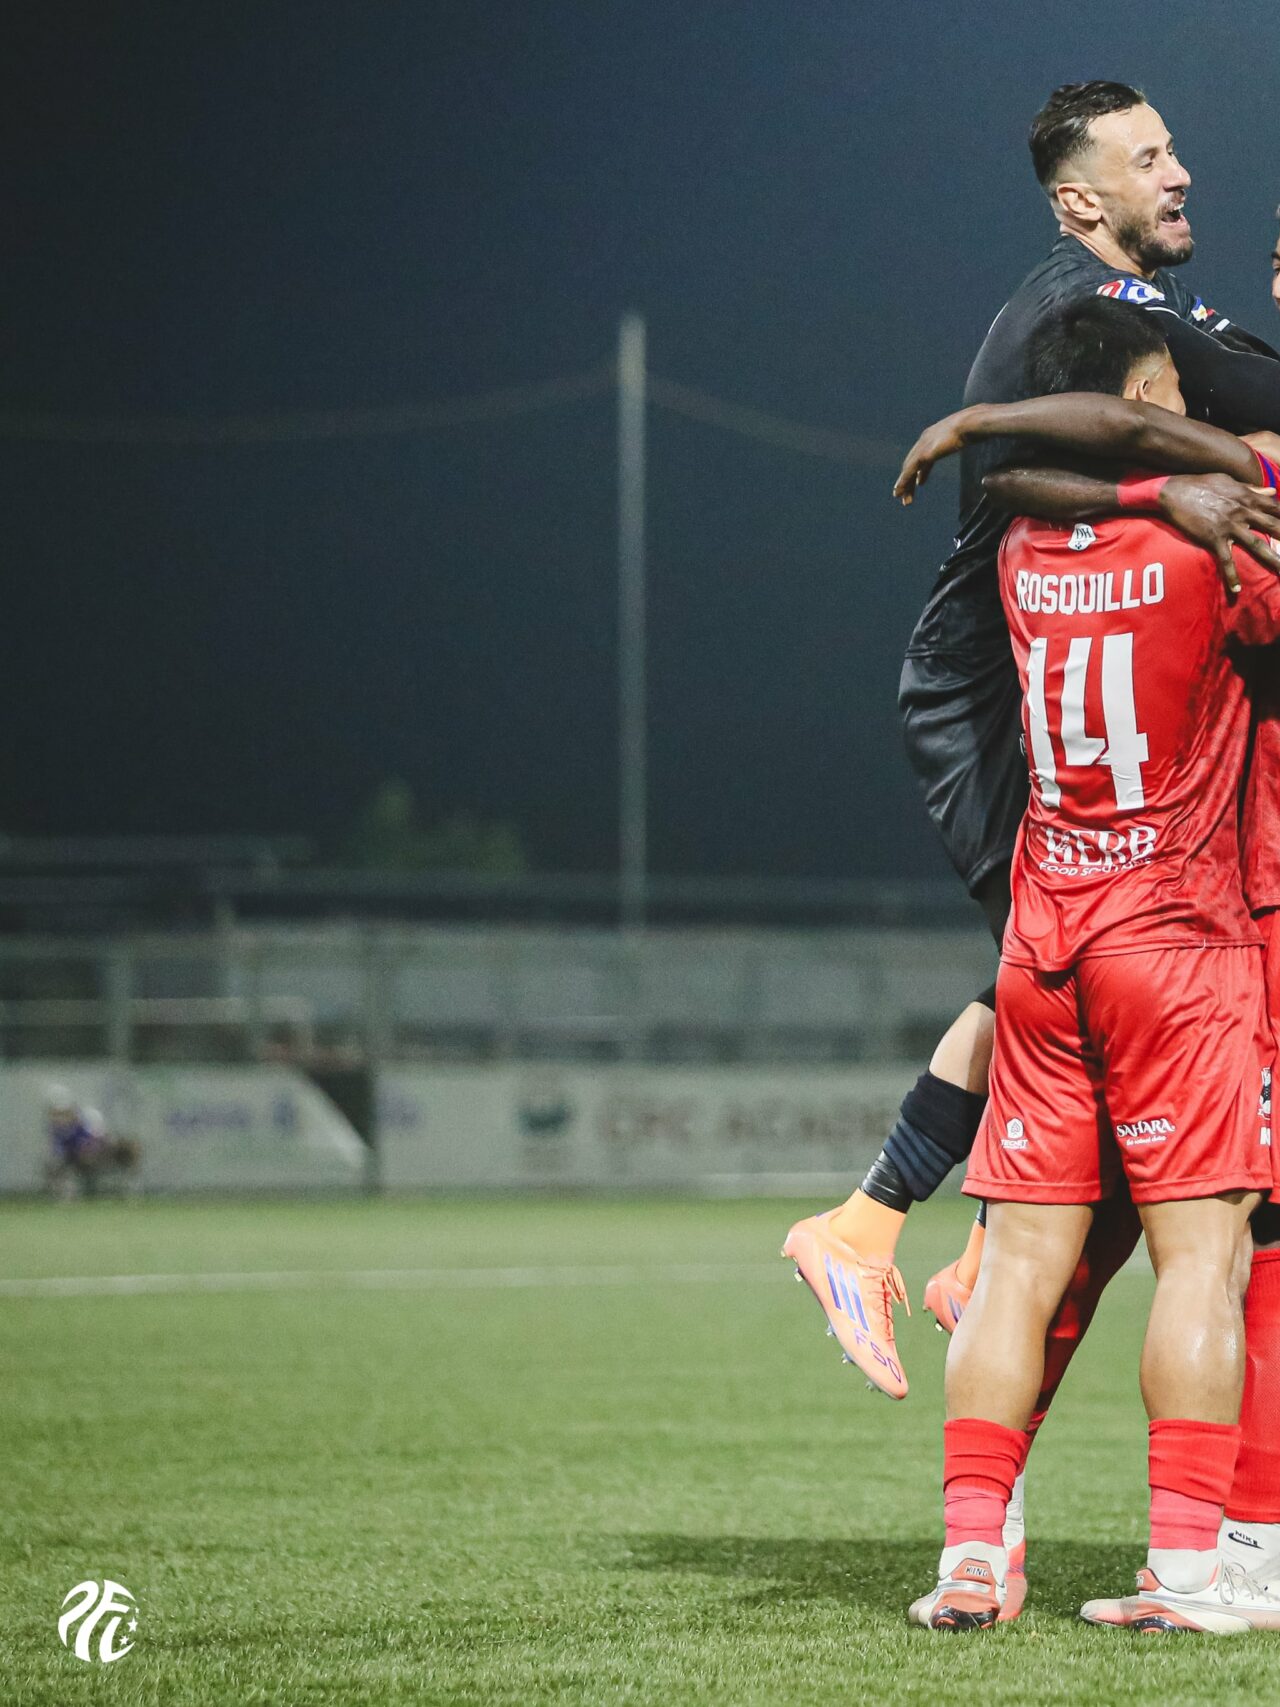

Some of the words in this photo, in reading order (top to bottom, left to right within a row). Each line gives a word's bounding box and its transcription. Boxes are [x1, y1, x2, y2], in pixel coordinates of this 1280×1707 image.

[1016, 562, 1165, 615] ROSQUILLO
[1025, 632, 1149, 811] 14
[1043, 825, 1157, 866] HERB
[1040, 861, 1079, 876] FOOD
[1116, 1118, 1173, 1137] SAHARA
